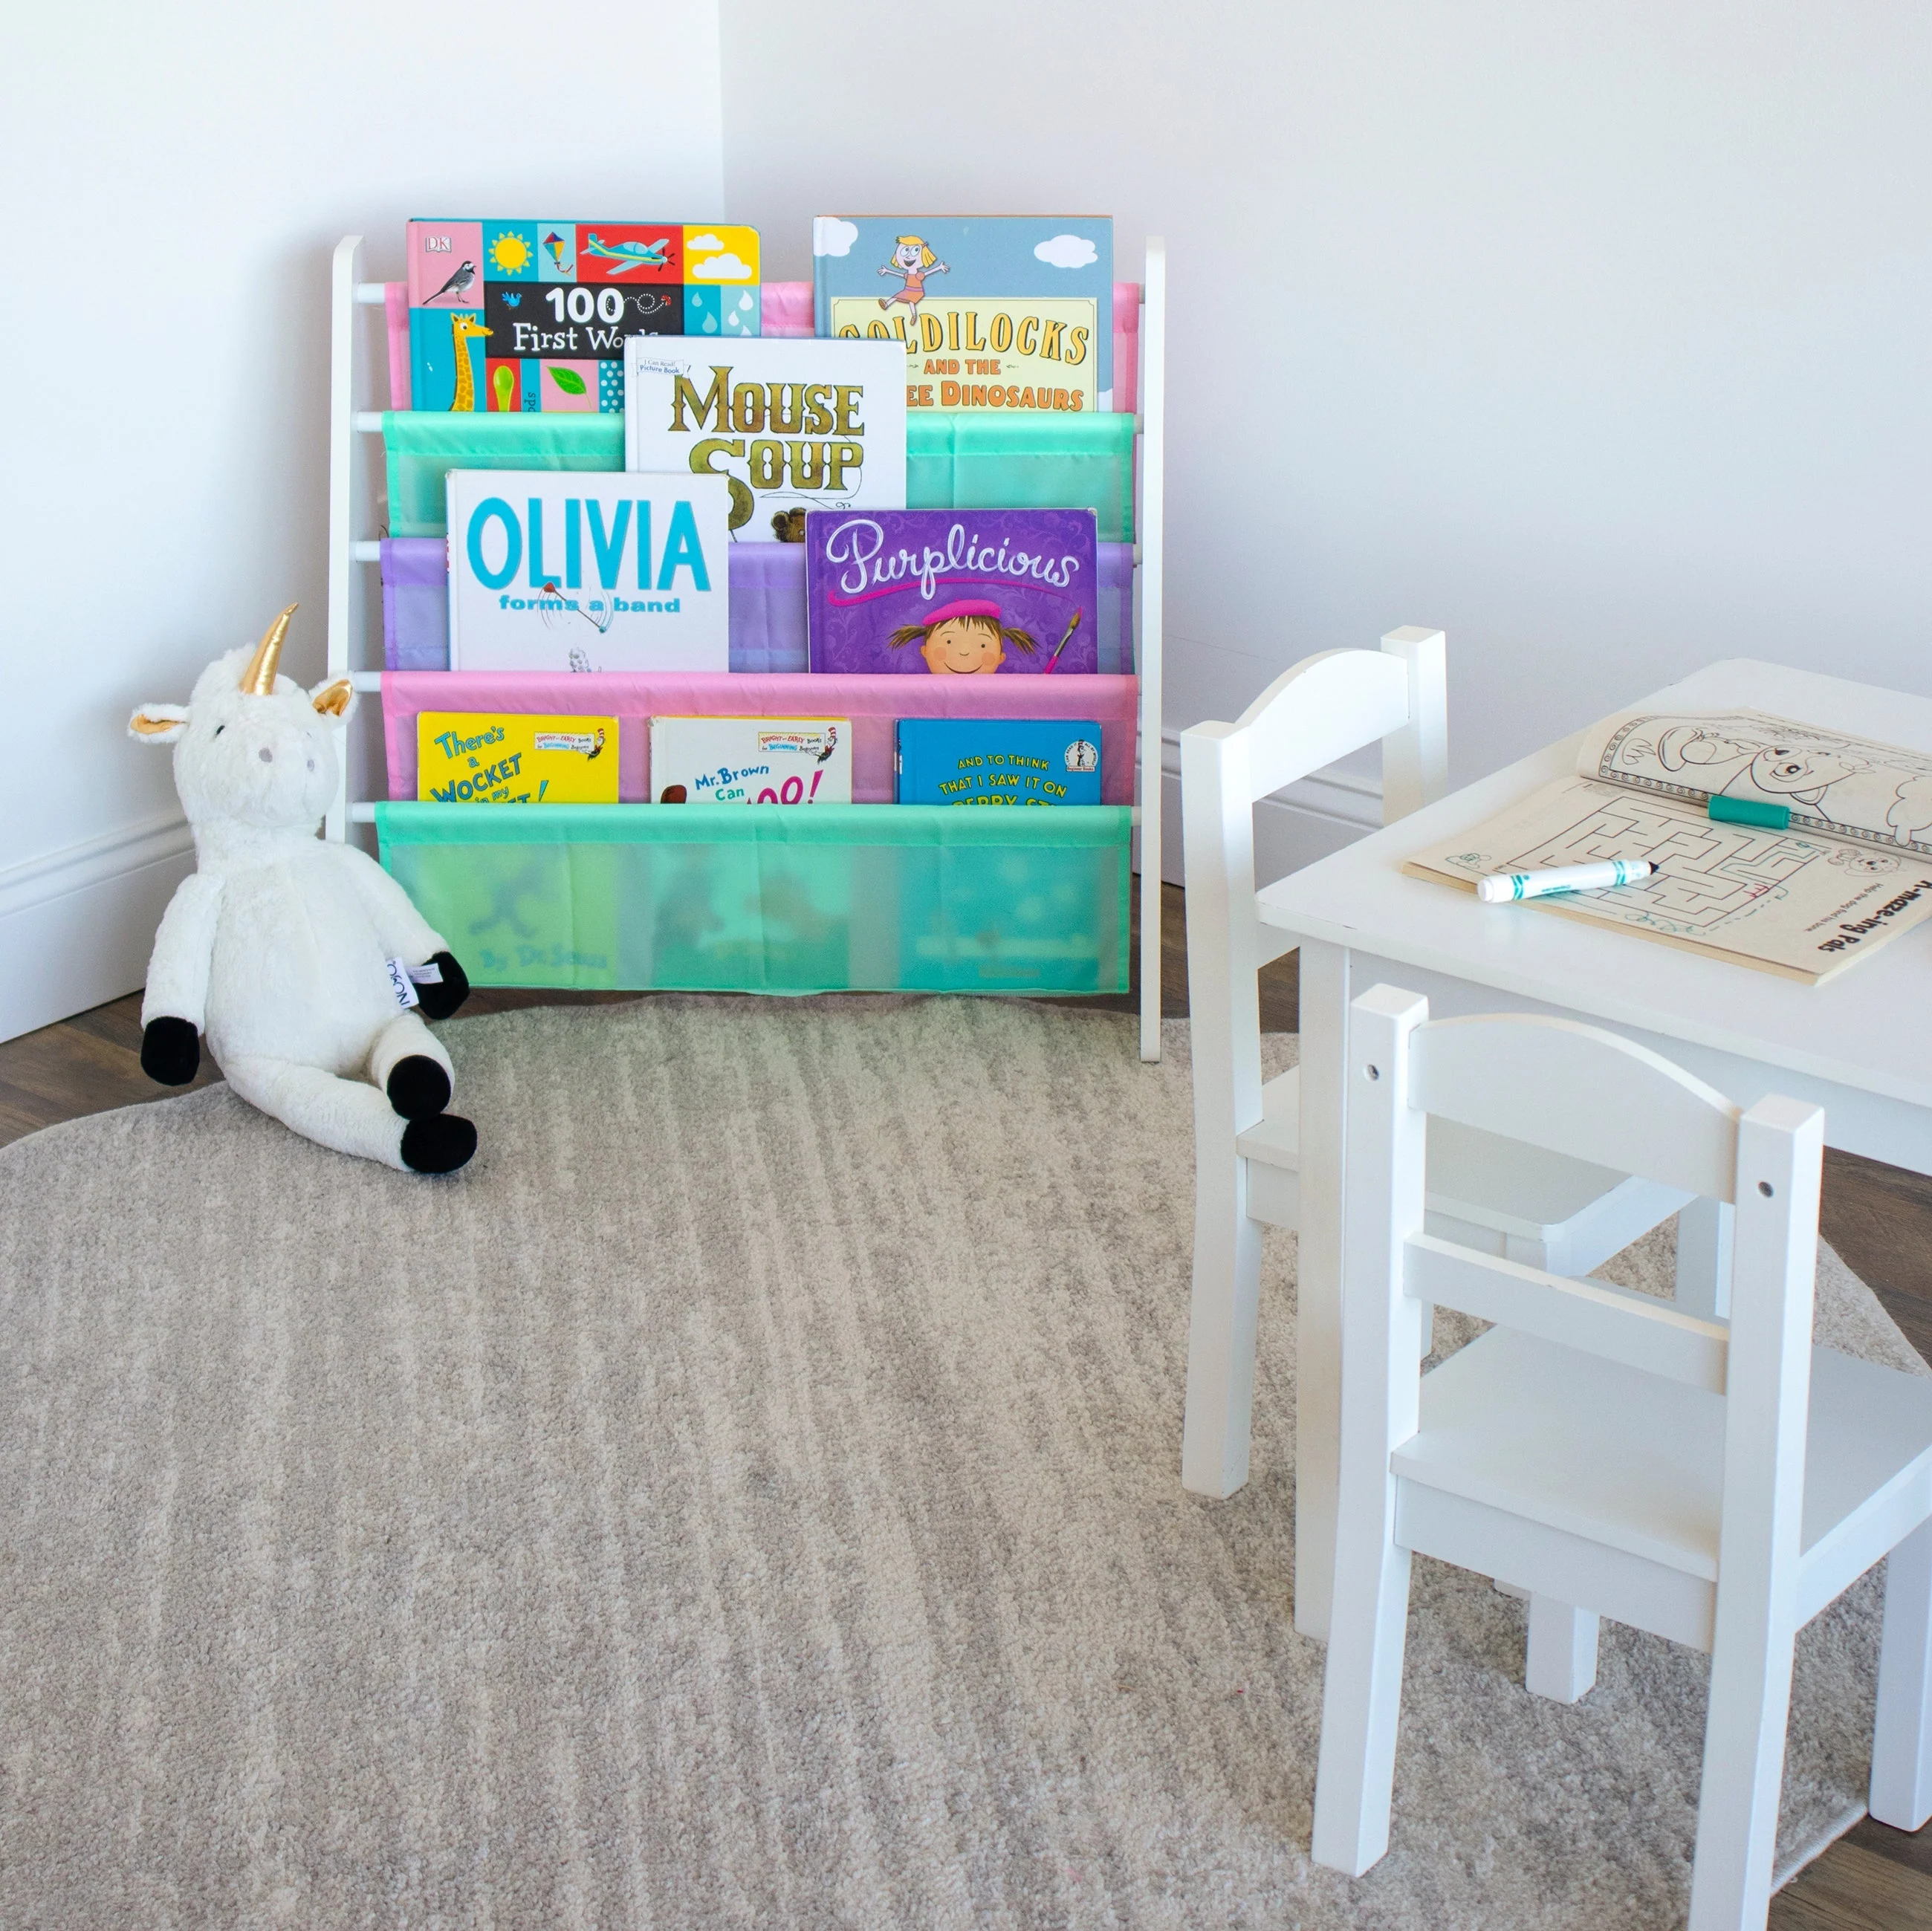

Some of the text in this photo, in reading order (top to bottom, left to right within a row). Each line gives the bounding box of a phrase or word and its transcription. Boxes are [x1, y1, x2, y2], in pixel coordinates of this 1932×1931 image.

[428, 236, 450, 250] DK
[545, 287, 624, 322] 100
[513, 322, 578, 351] First
[924, 359, 1001, 375] AND THE
[668, 366, 864, 435] MOUSE
[941, 380, 1084, 411] DINOSAURS
[689, 438, 864, 530] SOUP
[467, 496, 711, 591] OLIVIA
[826, 519, 1080, 600] Purplicious
[499, 594, 681, 613] forms a band
[434, 725, 505, 759] There's
[467, 756, 480, 768] a
[958, 754, 1049, 771] AND TO THINK
[429, 752, 522, 802] WOCKET
[695, 765, 770, 791] Mr. Brown
[939, 773, 1067, 797] THAT I SAW IT ON
[492, 786, 509, 801] my
[715, 788, 745, 801] Can
[1818, 935, 1861, 952] Pals
